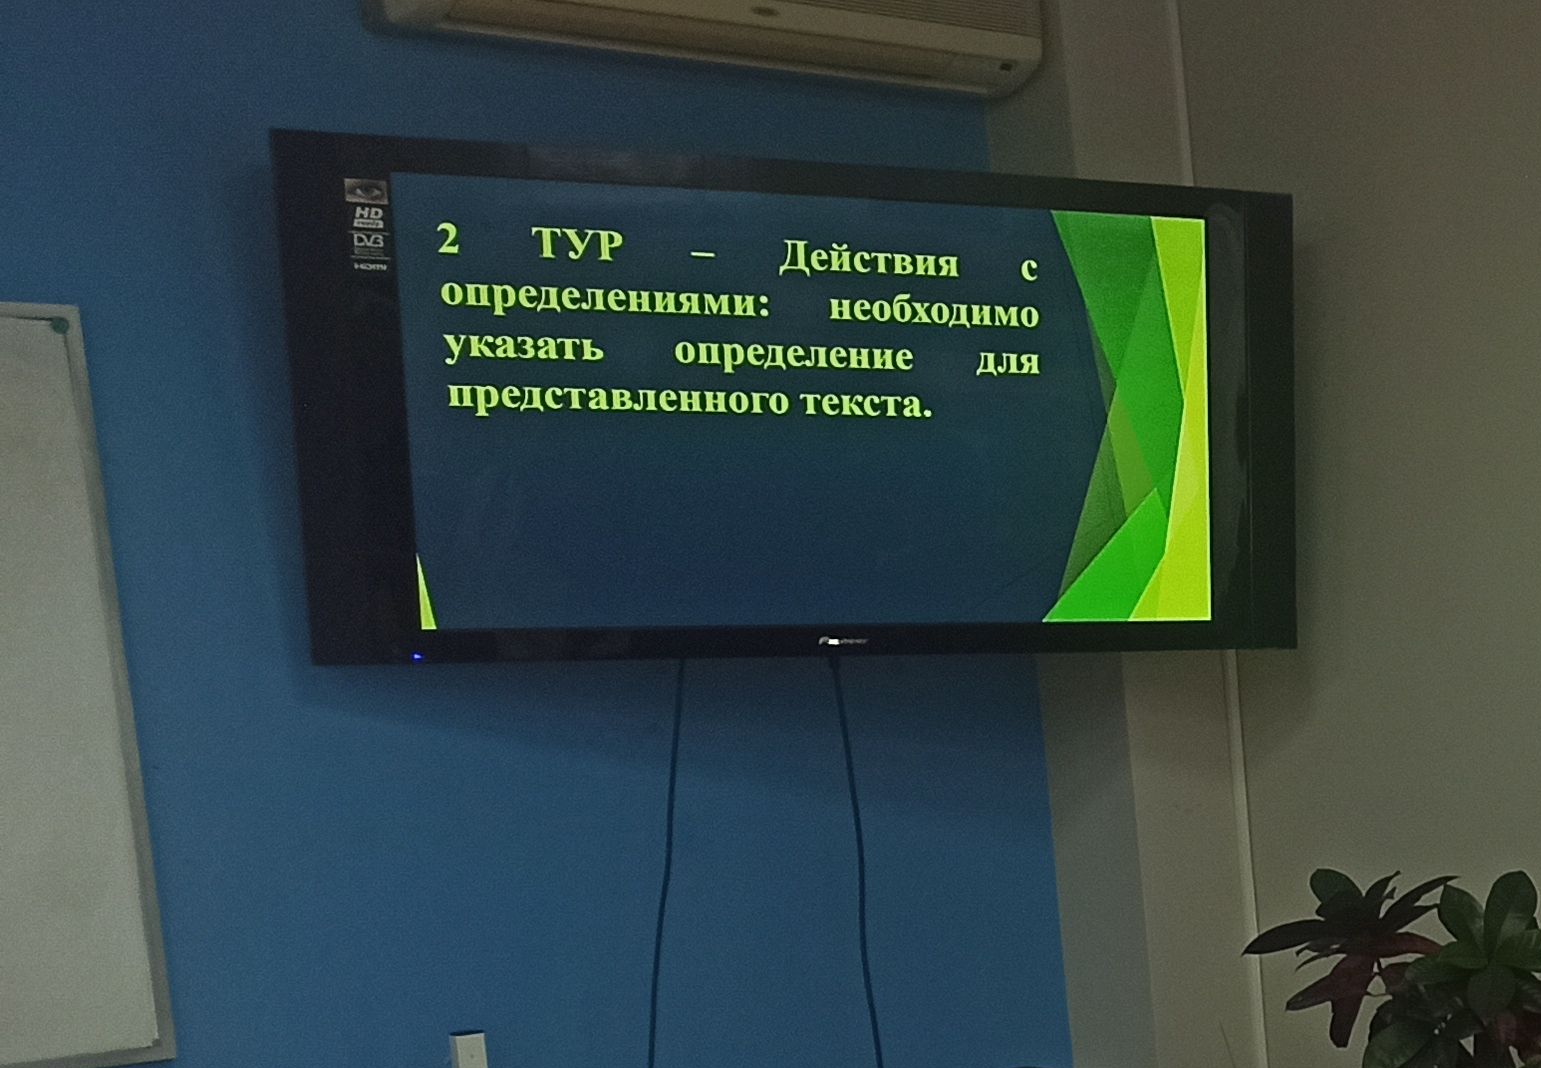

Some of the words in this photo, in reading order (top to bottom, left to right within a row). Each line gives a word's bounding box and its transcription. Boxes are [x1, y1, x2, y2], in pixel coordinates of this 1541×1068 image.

[354, 206, 384, 219] HD
[436, 222, 460, 254] 2
[531, 226, 623, 261] ТУР
[778, 239, 960, 278] Действия
[1020, 259, 1038, 282] с
[440, 282, 769, 317] определениями:
[829, 293, 1040, 329] необходимо
[442, 333, 605, 366] указать
[674, 341, 914, 374] определение
[975, 351, 1041, 377] для
[448, 384, 789, 419] представленного
[799, 391, 933, 419] текста.
